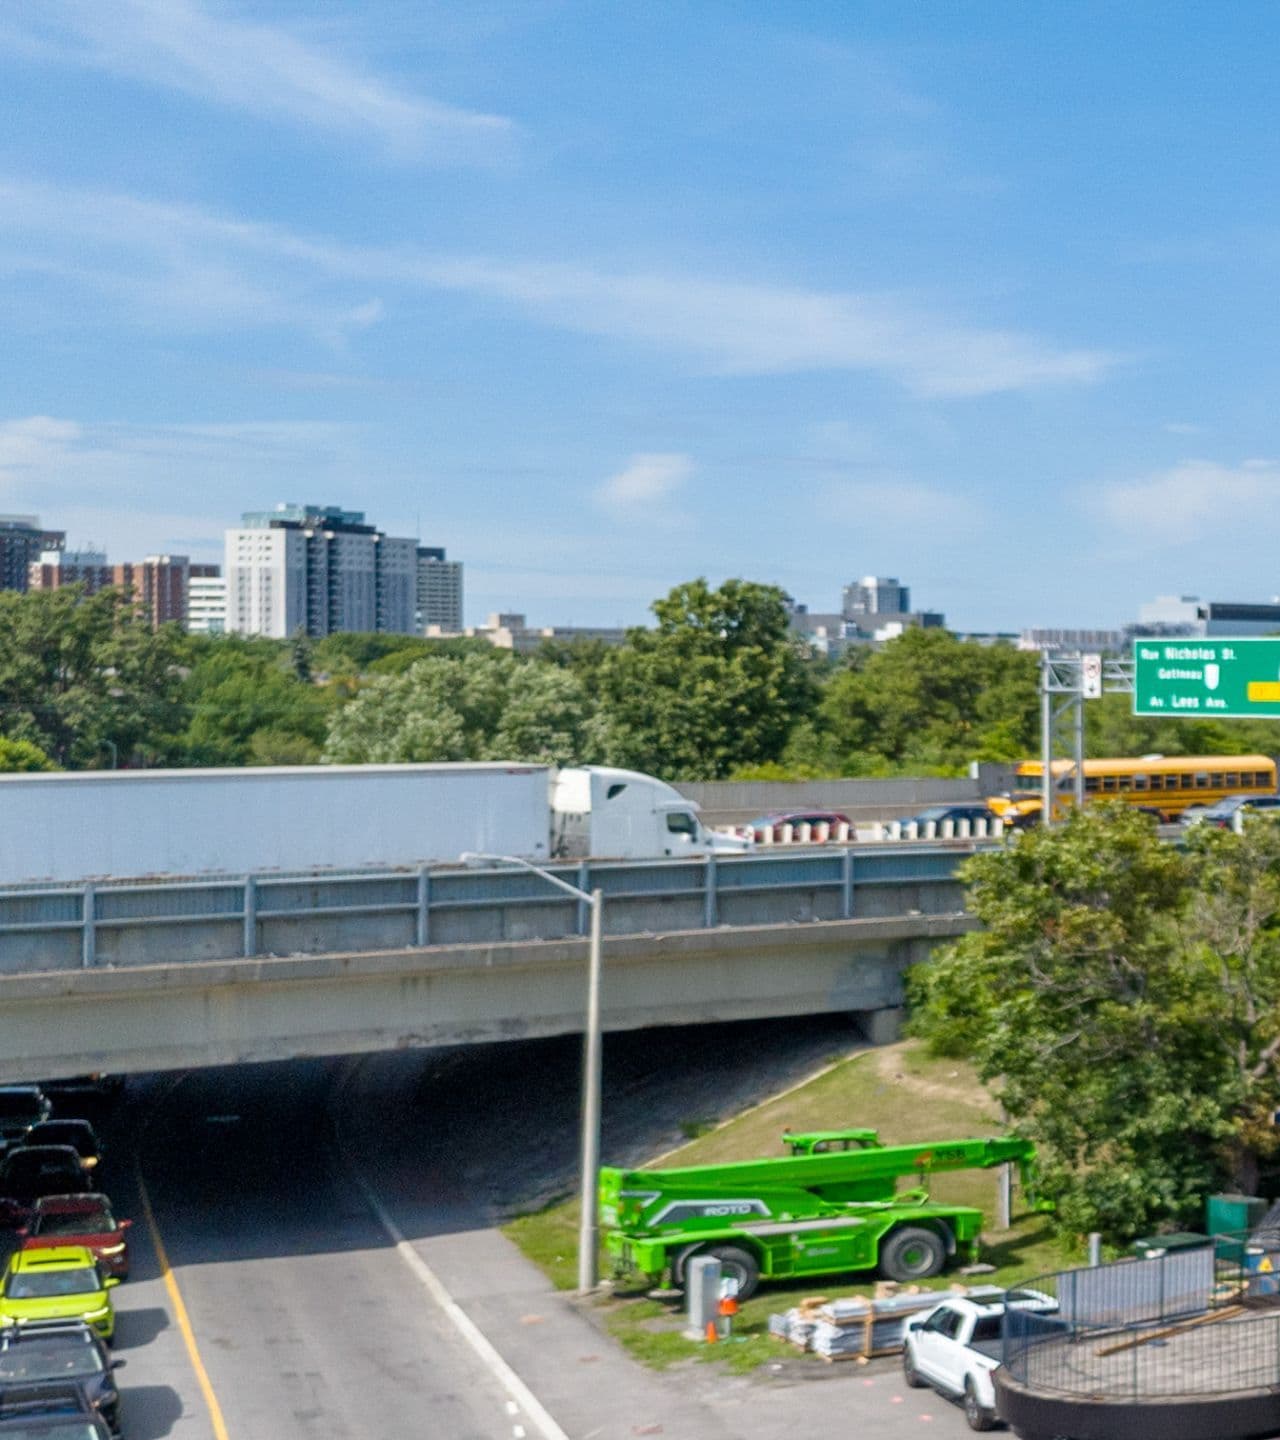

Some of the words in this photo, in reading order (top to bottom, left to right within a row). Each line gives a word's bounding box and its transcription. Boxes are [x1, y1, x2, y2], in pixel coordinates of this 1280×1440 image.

[1164, 647, 1216, 660] Nicholas
[1158, 668, 1203, 680] Gatineau
[1172, 694, 1199, 708] Lees
[704, 1204, 752, 1216] ROTO
